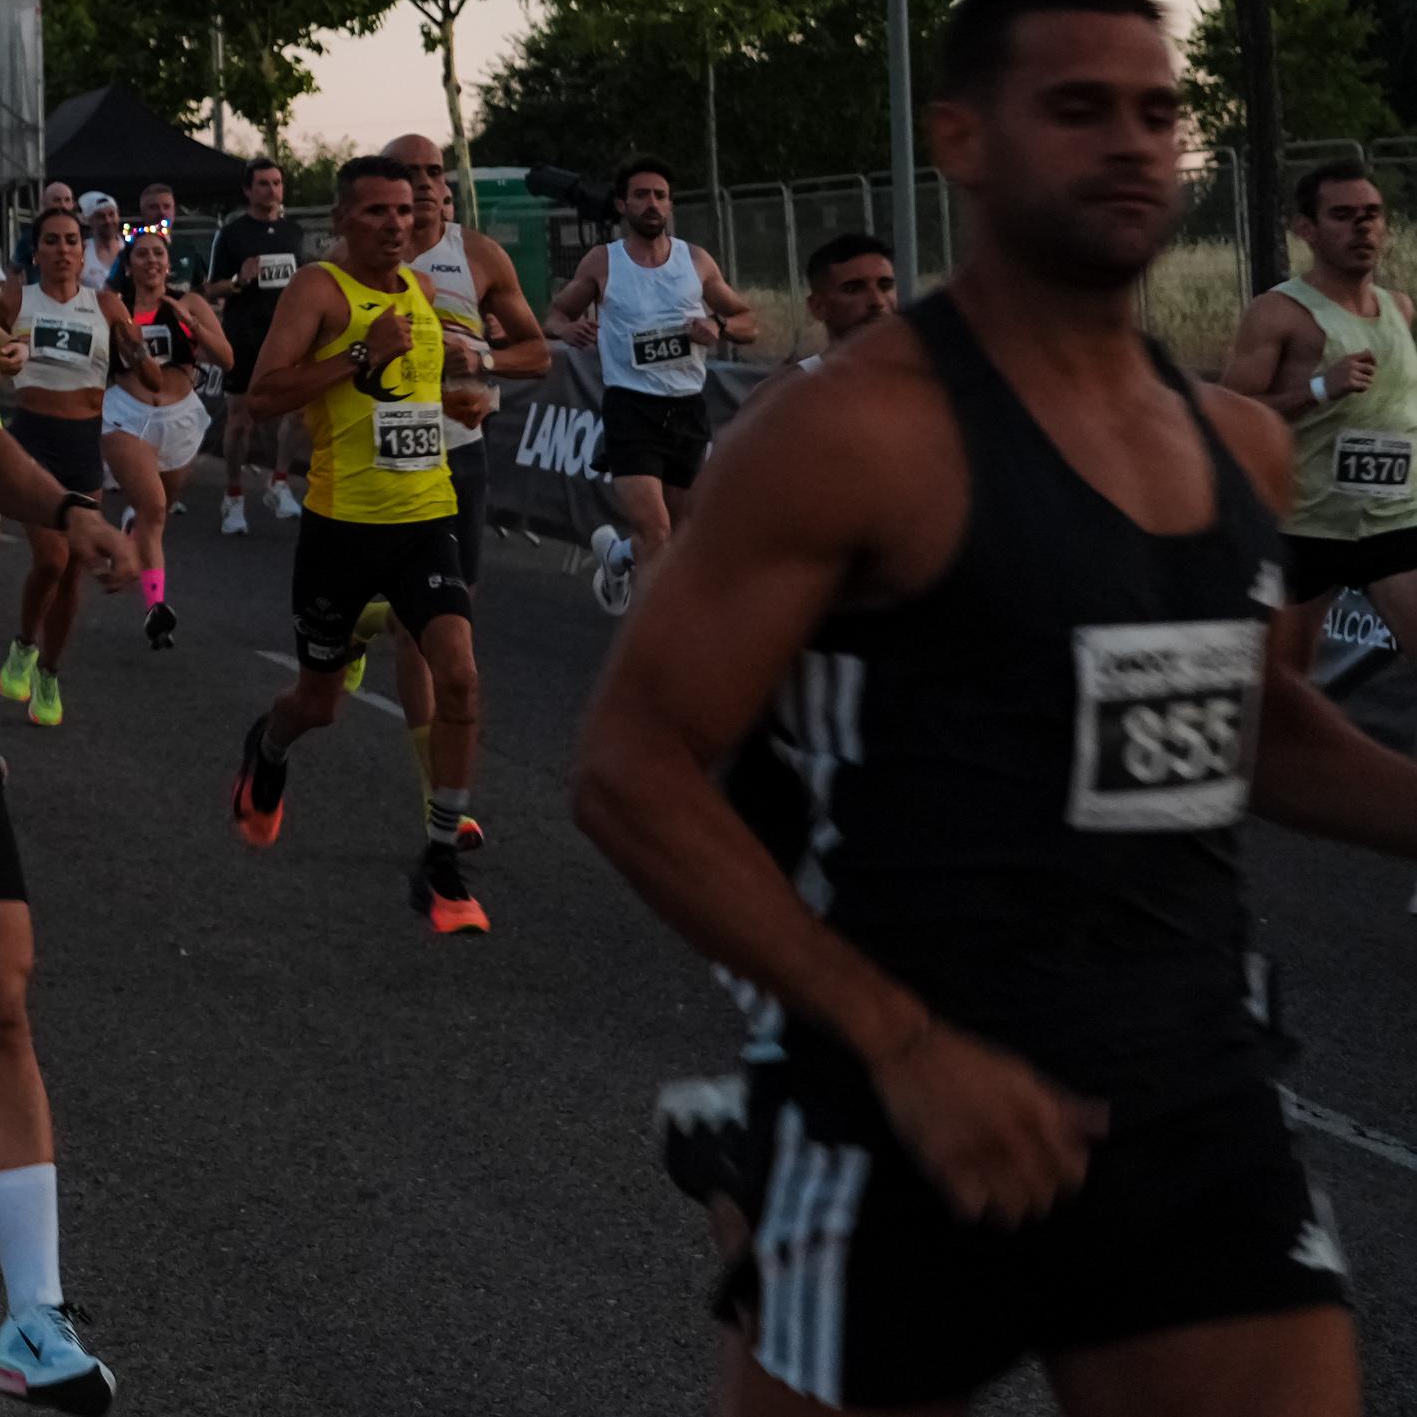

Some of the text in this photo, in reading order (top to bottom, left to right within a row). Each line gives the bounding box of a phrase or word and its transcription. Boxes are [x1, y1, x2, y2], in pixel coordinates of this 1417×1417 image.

[55, 330, 70, 350] 2
[643, 338, 683, 362] 546
[384, 427, 439, 456] 1339
[1342, 455, 1407, 482] 1370
